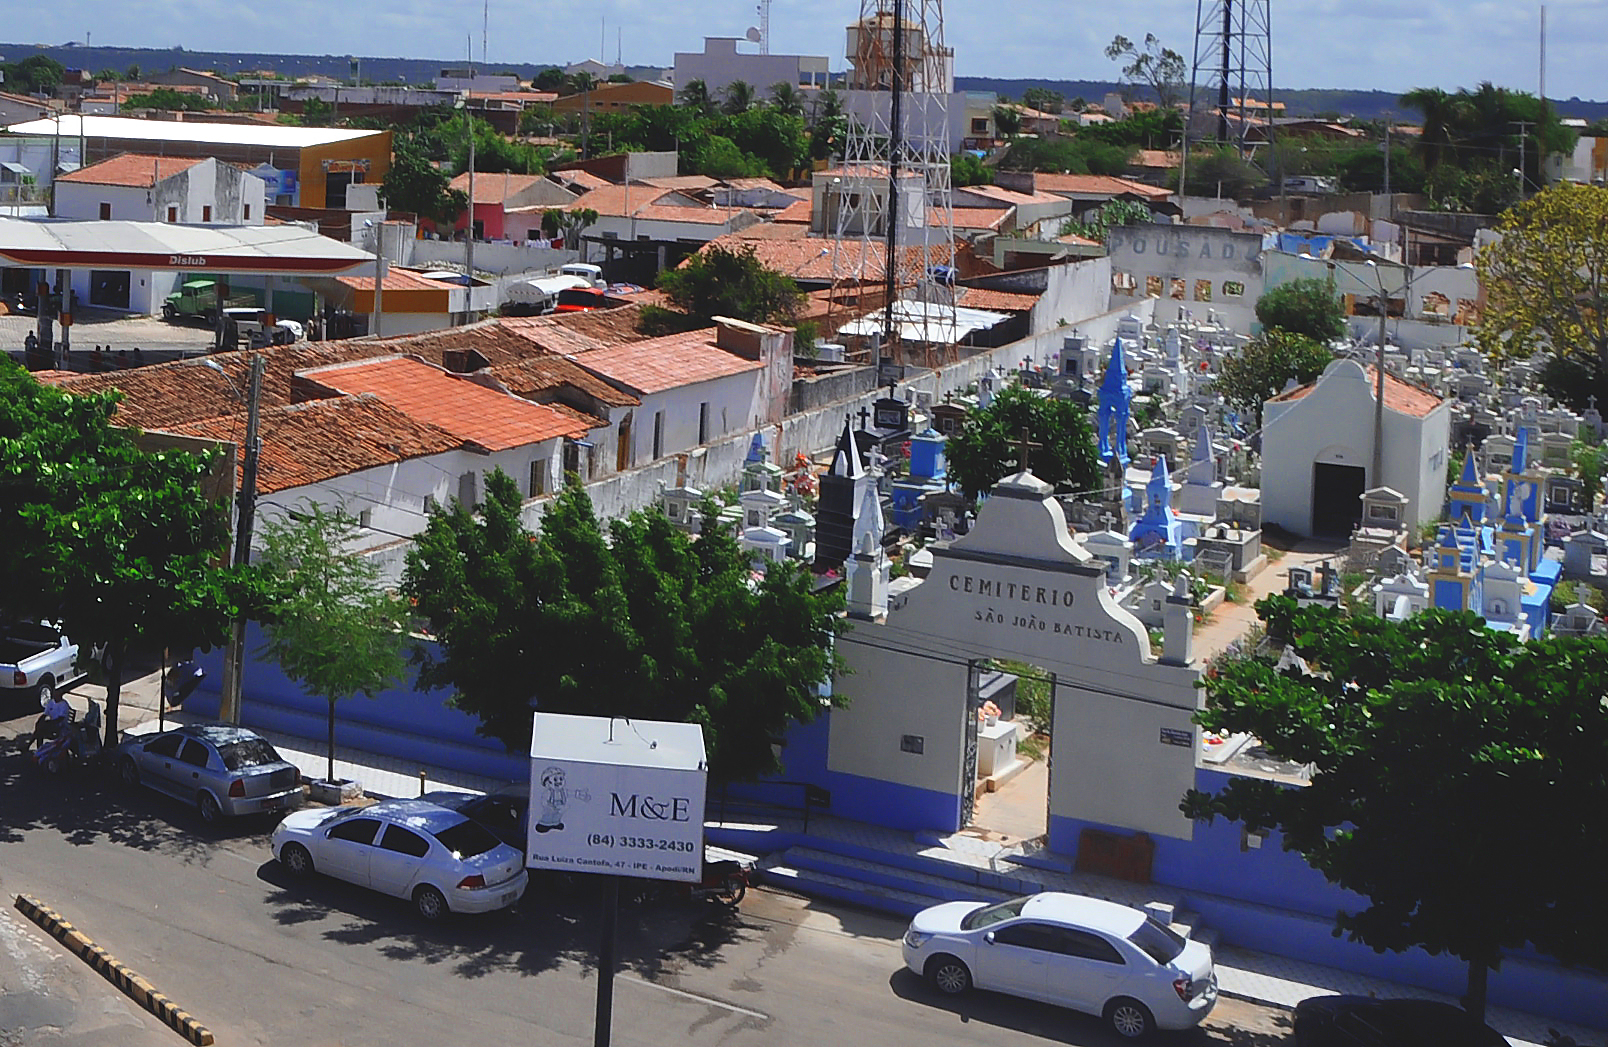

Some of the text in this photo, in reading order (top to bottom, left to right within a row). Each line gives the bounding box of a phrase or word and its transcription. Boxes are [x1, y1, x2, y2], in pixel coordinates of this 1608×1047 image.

[169, 255, 207, 265] Dislub
[949, 574, 1075, 608] CEMITERIO
[974, 607, 1124, 644] SÃO JOÃO BATISTA
[609, 792, 691, 823] M&E
[587, 833, 695, 853] (84) 3333-2430
[533, 853, 550, 862] Rua
